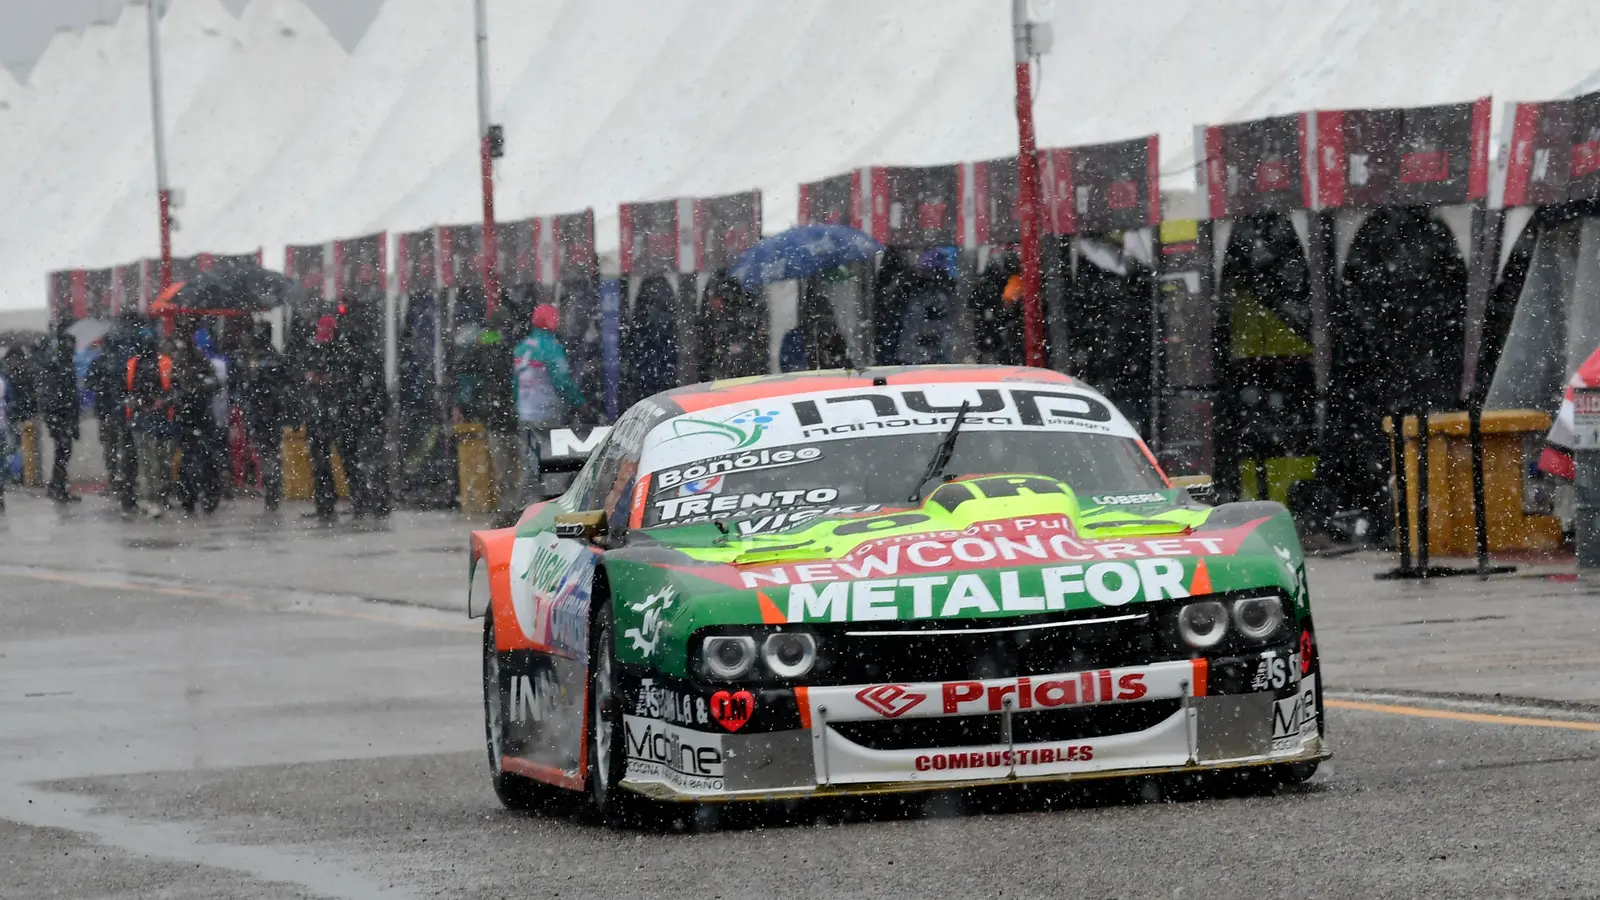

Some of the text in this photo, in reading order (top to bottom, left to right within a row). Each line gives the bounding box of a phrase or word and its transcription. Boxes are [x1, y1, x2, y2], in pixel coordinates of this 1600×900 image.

[654, 488, 839, 520] TRENTO
[744, 535, 1223, 589] NEWCONCRET
[787, 557, 1188, 622] METALFOR
[942, 670, 1147, 713] Prialis
[915, 745, 1094, 773] COMBUSTIBLES
